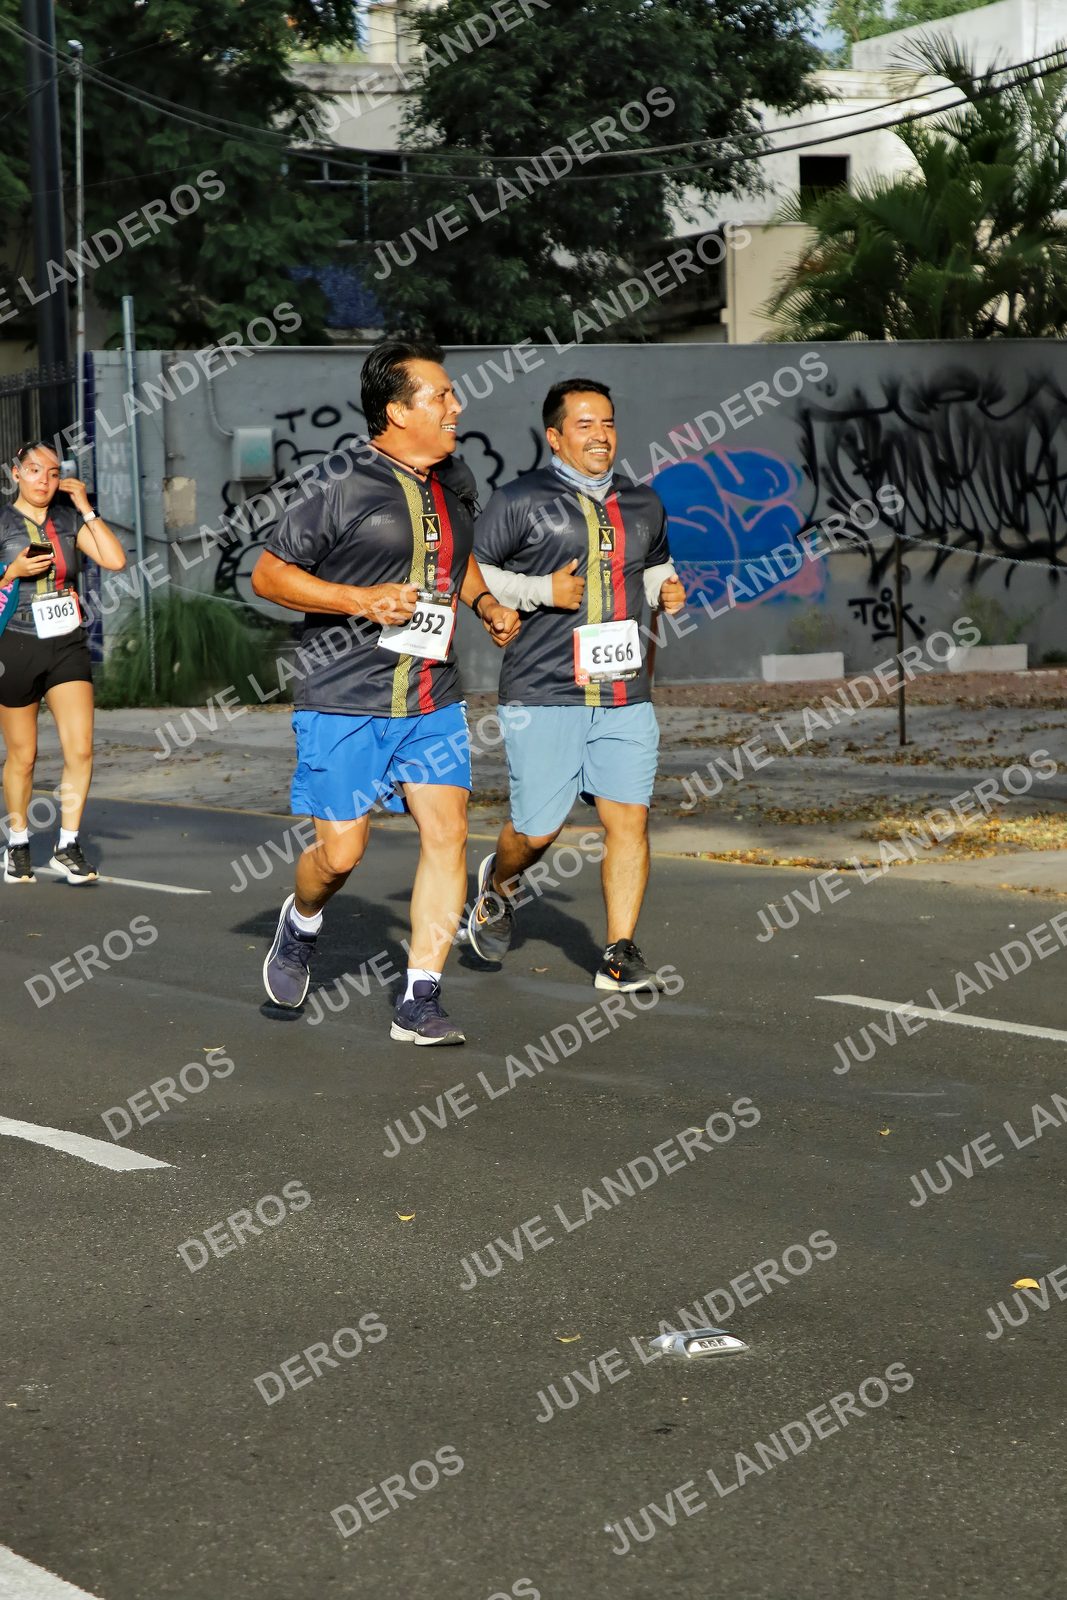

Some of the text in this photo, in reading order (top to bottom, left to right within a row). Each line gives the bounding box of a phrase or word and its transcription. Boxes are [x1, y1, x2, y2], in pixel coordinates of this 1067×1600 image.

[275, 400, 366, 433] TO
[38, 602, 75, 621] 13063
[591, 642, 633, 664] 9953
